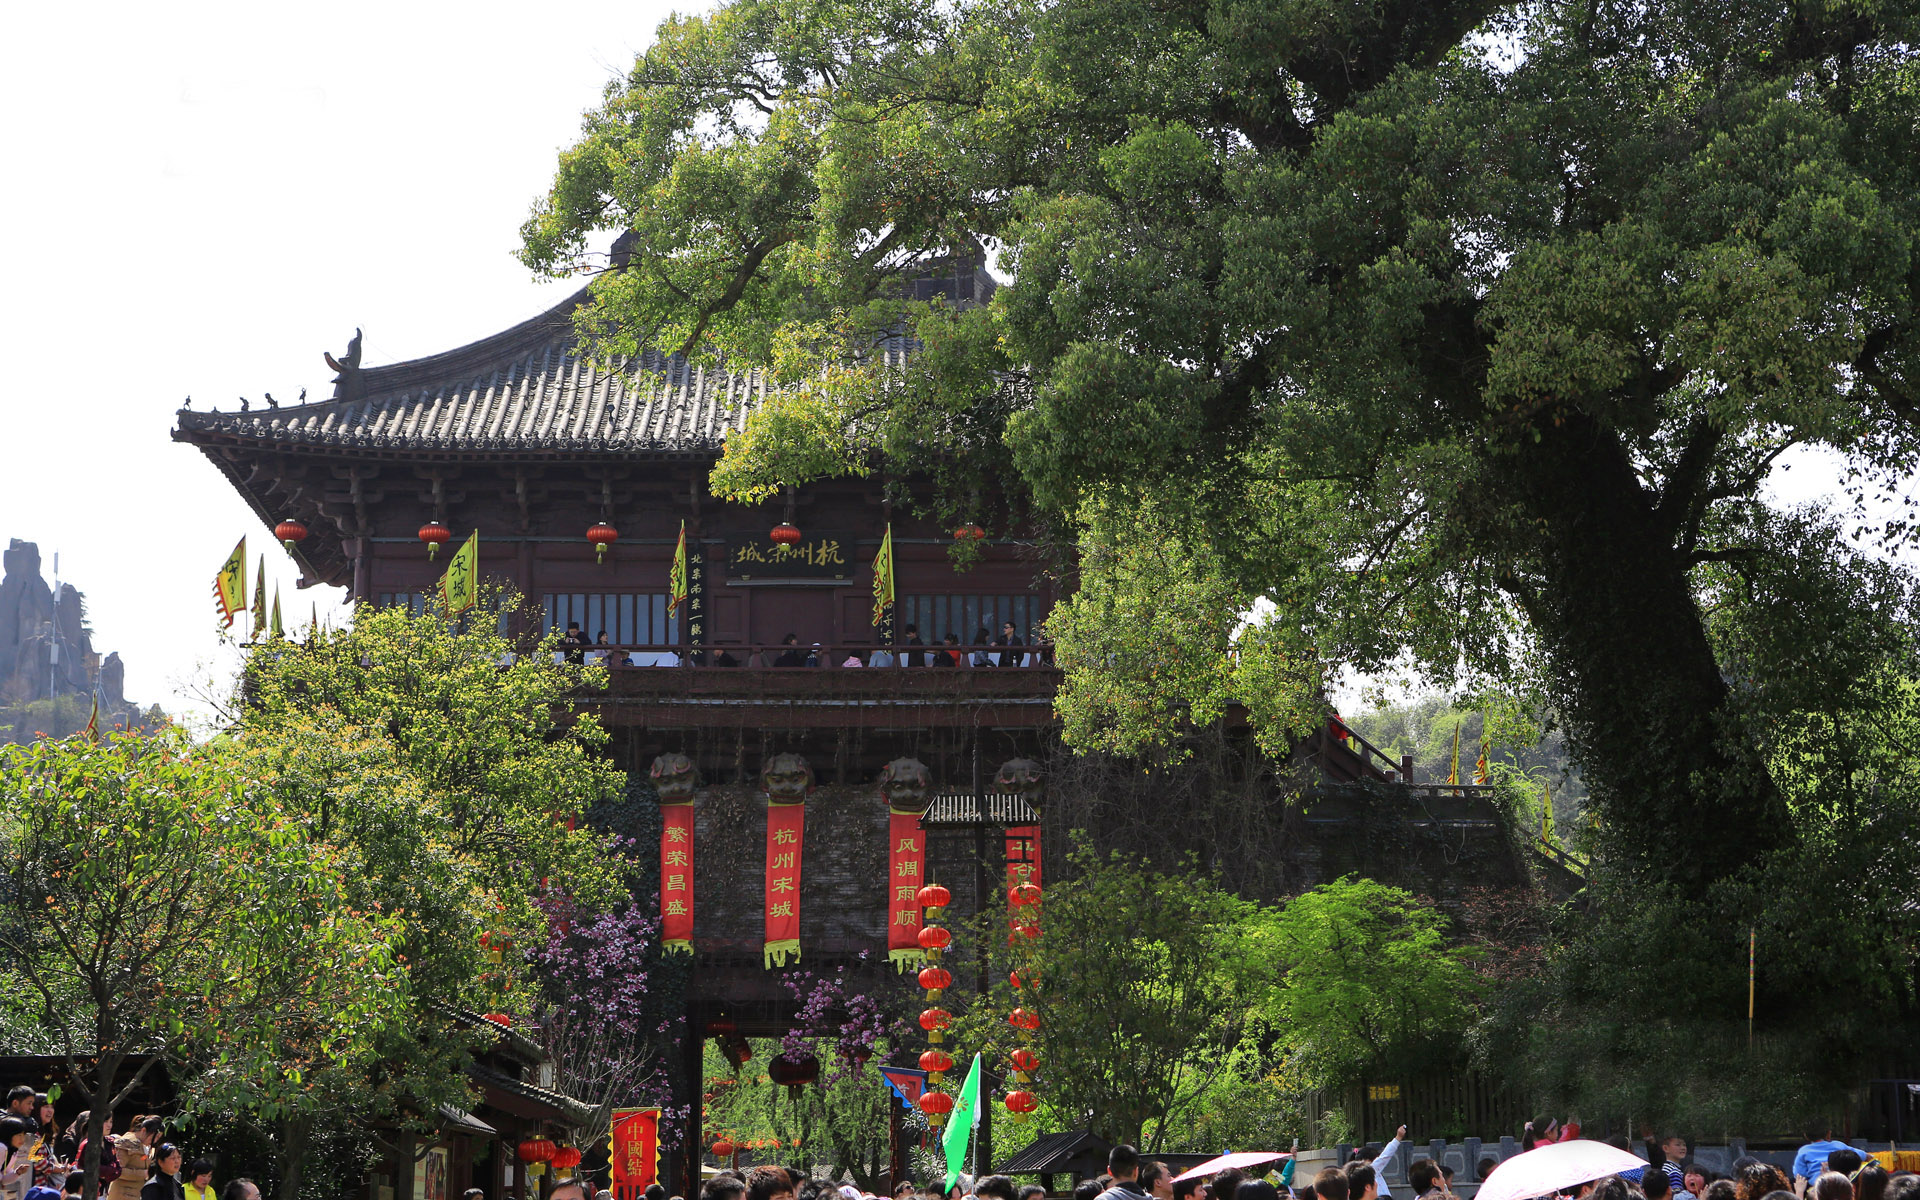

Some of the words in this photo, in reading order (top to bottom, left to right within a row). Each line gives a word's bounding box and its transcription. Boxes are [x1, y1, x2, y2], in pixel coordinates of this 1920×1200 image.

[451, 554, 468, 599] 宋城
[665, 826, 688, 916] 繁荣昌盛
[769, 828, 797, 918] 杭州宋城
[893, 838, 919, 926] 风调雨顺
[627, 1121, 643, 1176] 中國結
